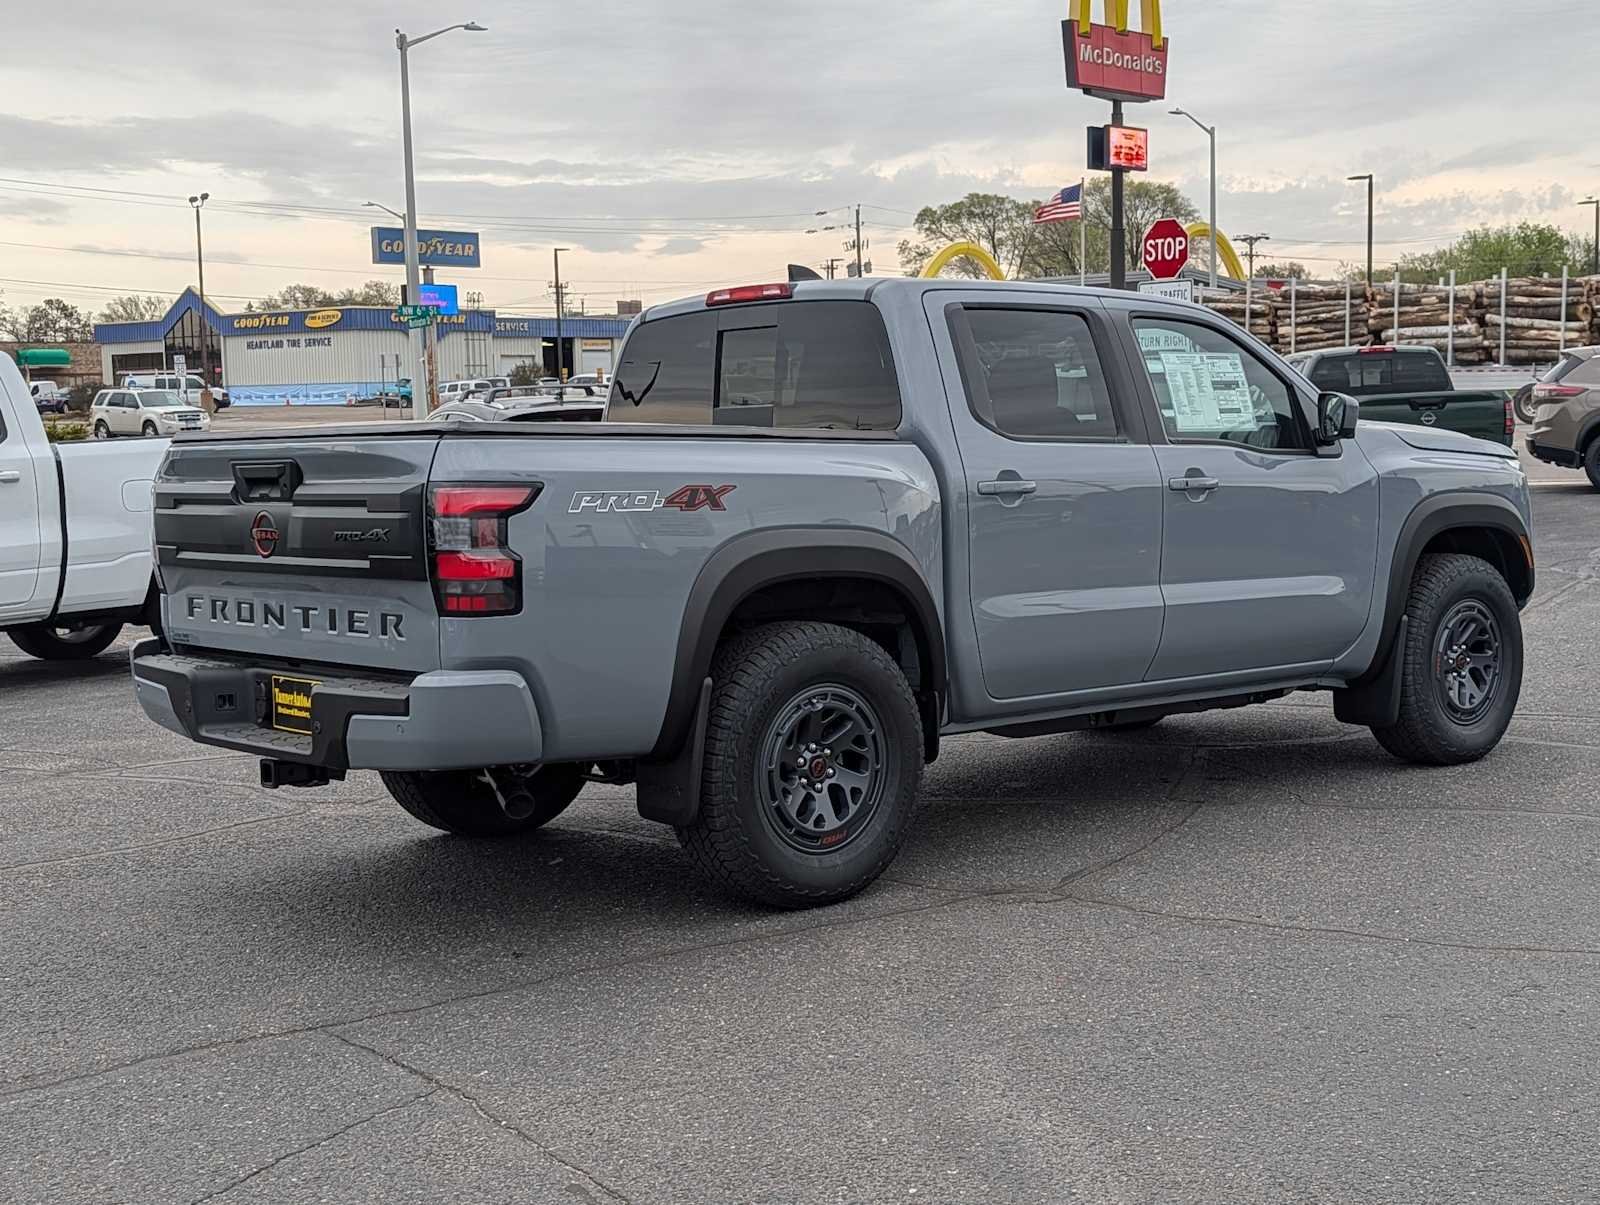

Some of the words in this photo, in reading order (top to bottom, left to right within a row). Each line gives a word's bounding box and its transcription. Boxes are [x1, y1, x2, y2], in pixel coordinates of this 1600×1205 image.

[1080, 43, 1163, 74] McDonald's
[381, 238, 475, 257] GODYEAR
[1145, 236, 1186, 262] STOP
[402, 306, 414, 316] NW
[233, 315, 289, 328] GOODYEAR
[391, 312, 466, 324] GOYEAR
[495, 321, 529, 332] SERVICE
[246, 340, 284, 350] HEARTLAND
[286, 338, 301, 348] TIRE
[304, 337, 332, 348] SERVICE
[1140, 336, 1161, 348] TURN
[567, 485, 737, 513] PRO-4X
[334, 528, 391, 542] PRO-4X
[187, 596, 406, 642] FRONTIER
